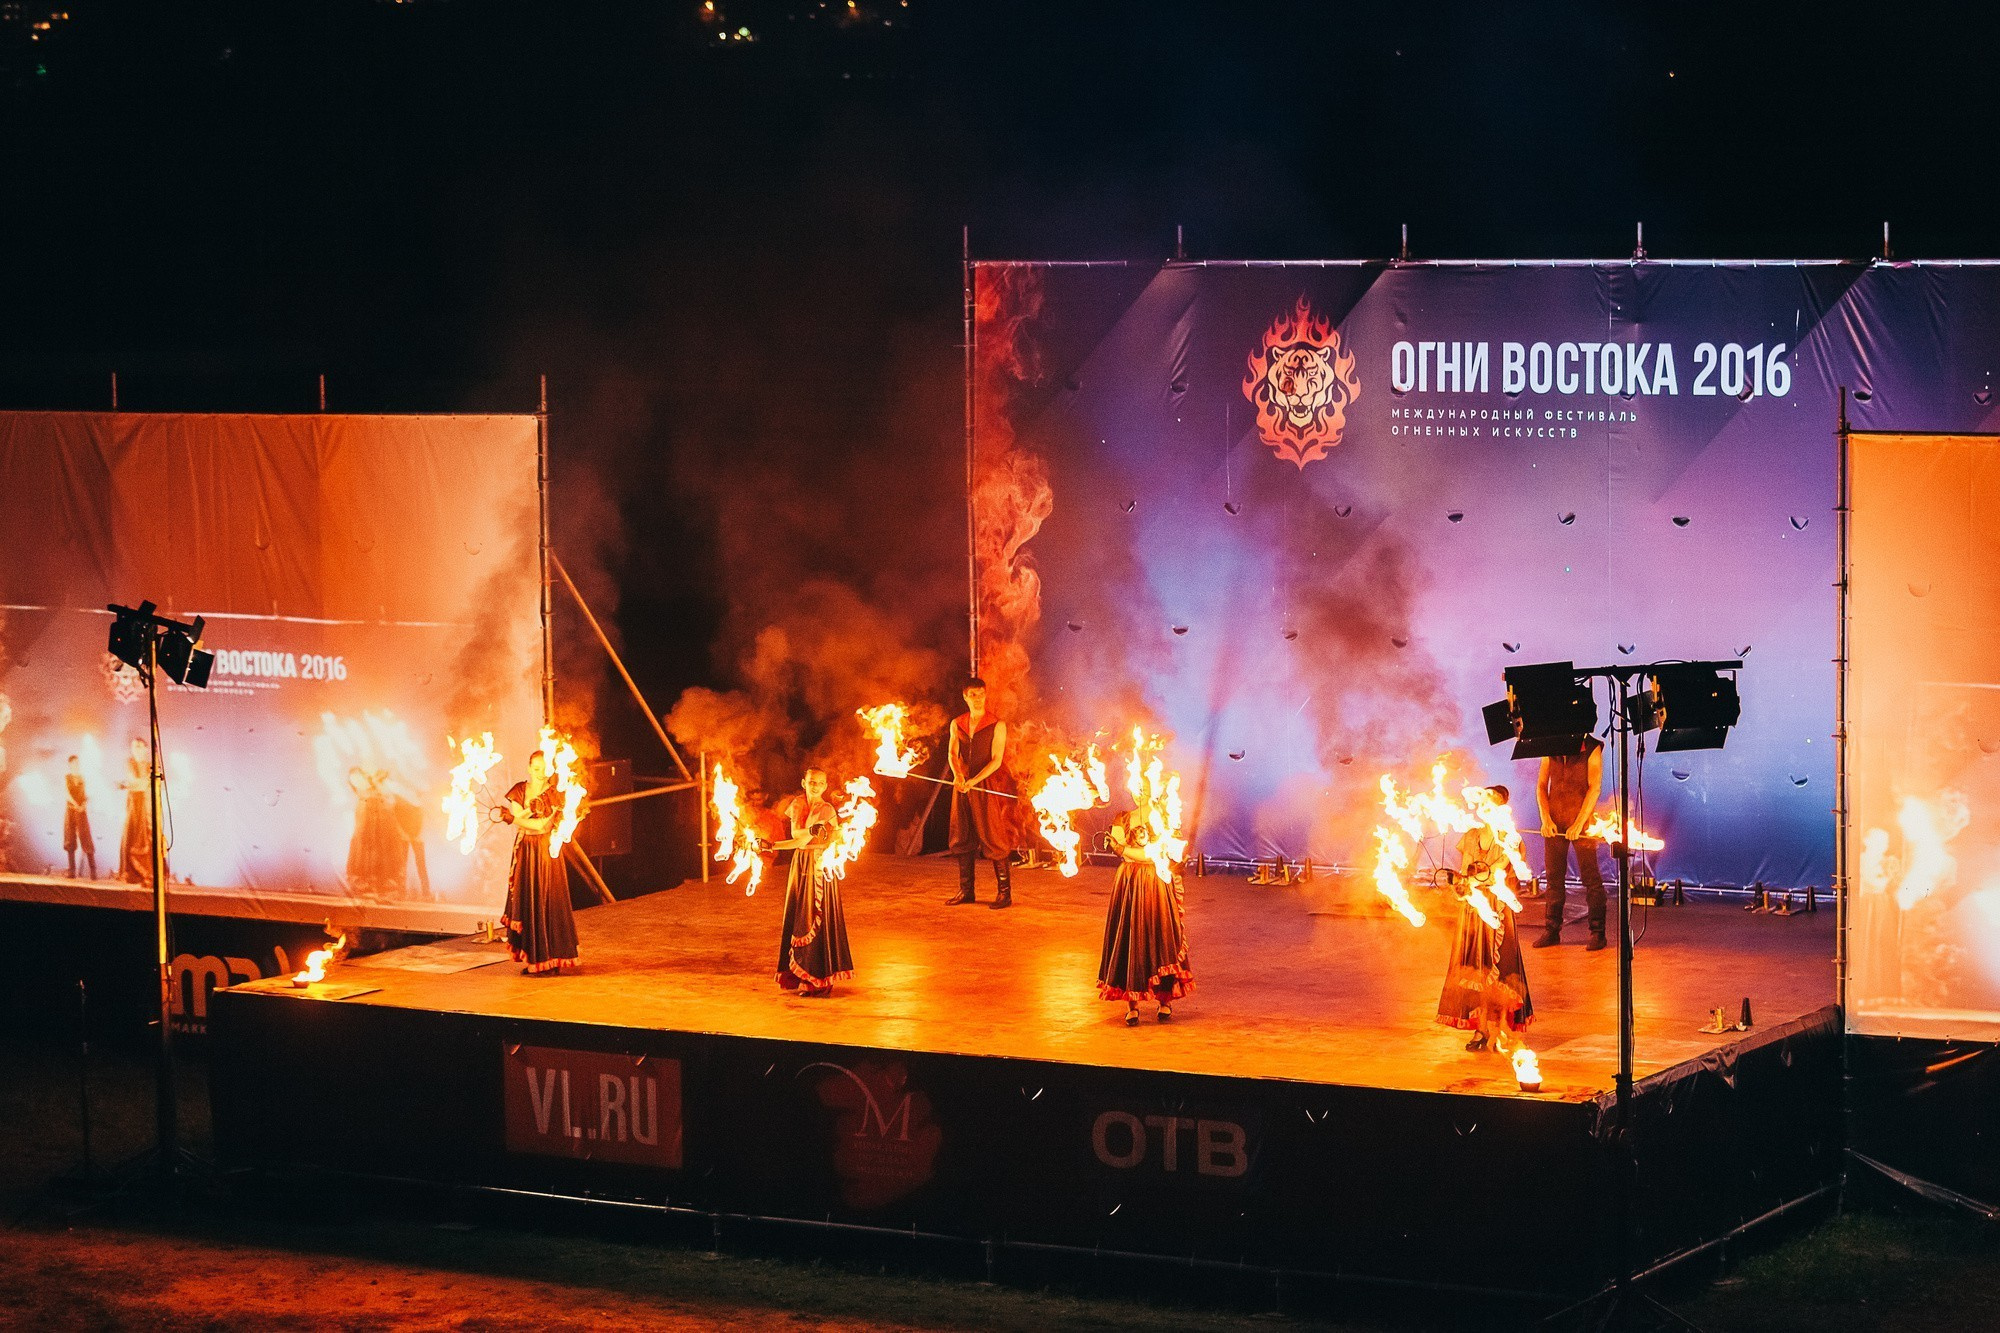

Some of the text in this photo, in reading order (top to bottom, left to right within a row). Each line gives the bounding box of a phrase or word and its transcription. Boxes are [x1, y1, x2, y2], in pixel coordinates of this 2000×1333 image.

[1391, 341, 1792, 397] ОГНИ ВОСТОКА 2016
[1391, 408, 1637, 422] МЕЖДУНАРОДНЫЙ ФЕСТИВАЛЬ
[1391, 425, 1578, 438] ОГНЕННЫХ ИСКУССТВ
[217, 650, 297, 677] ВОСТОКА
[302, 654, 347, 680] 2016
[1091, 1110, 1249, 1178] ОТВ
